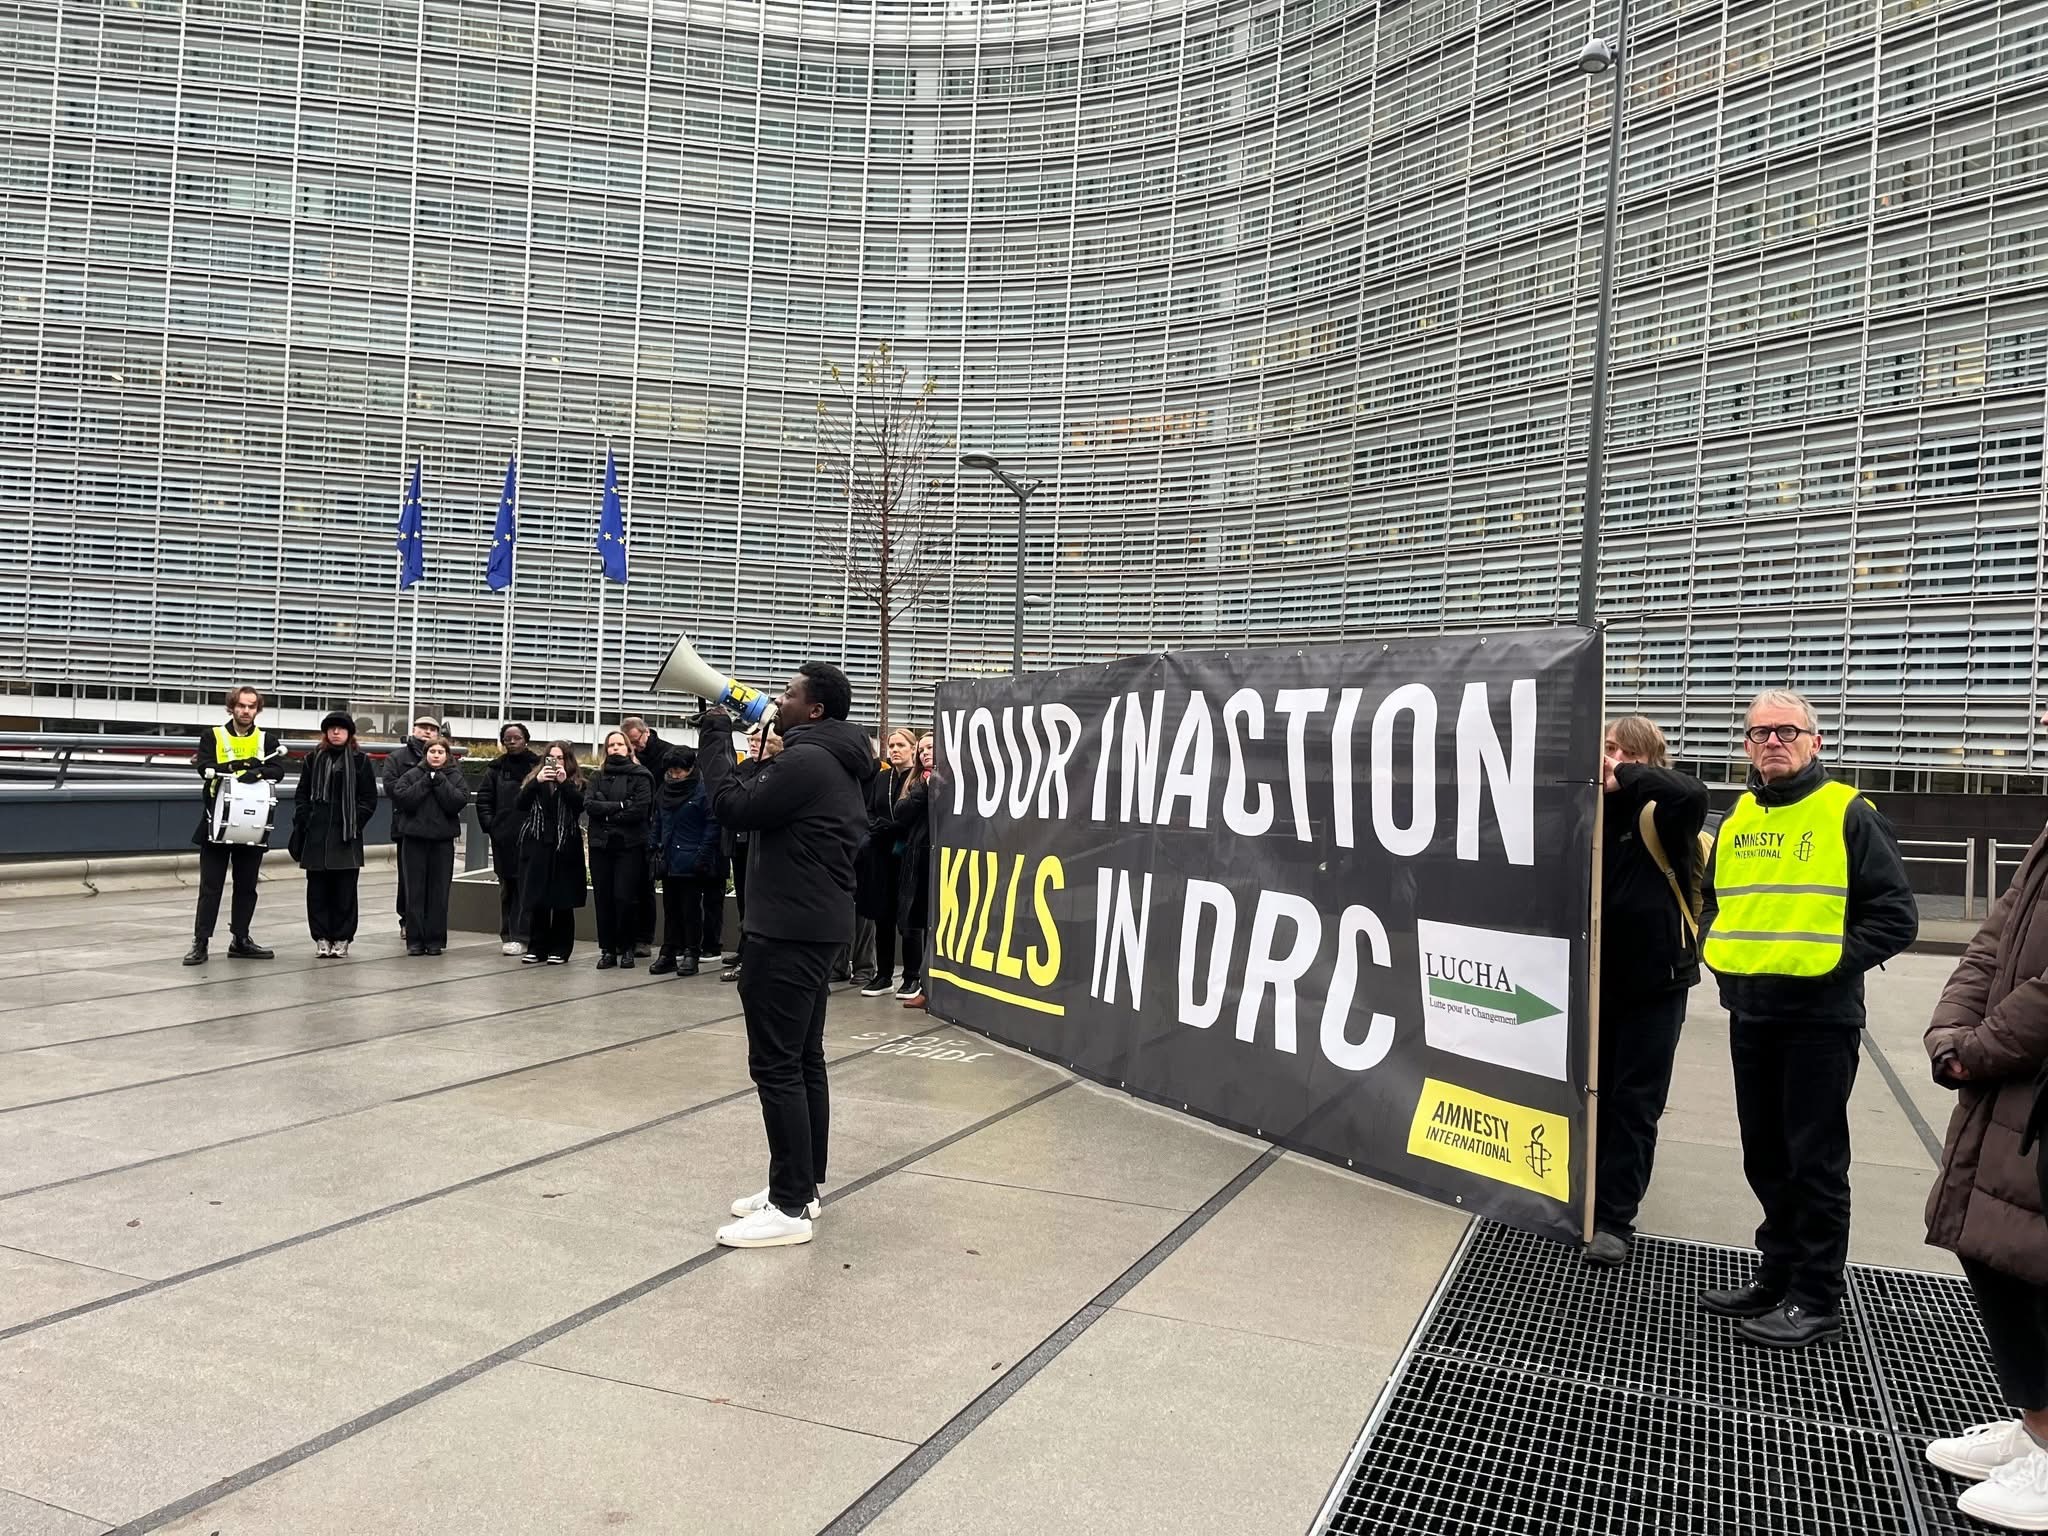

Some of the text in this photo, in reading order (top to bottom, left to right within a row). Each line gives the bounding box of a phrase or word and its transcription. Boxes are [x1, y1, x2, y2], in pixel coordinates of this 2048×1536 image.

[941, 678, 1538, 867] YOUR INACTION
[1734, 832, 1785, 848] AMNESTY
[936, 847, 1397, 1072] KILLS IN DRC
[1425, 952, 1513, 992] LUCHA
[1428, 997, 1518, 1025] Lutte pour le Changement
[1431, 1100, 1509, 1143] AMNESTY
[1425, 1126, 1512, 1163] INTERNATIONAL
